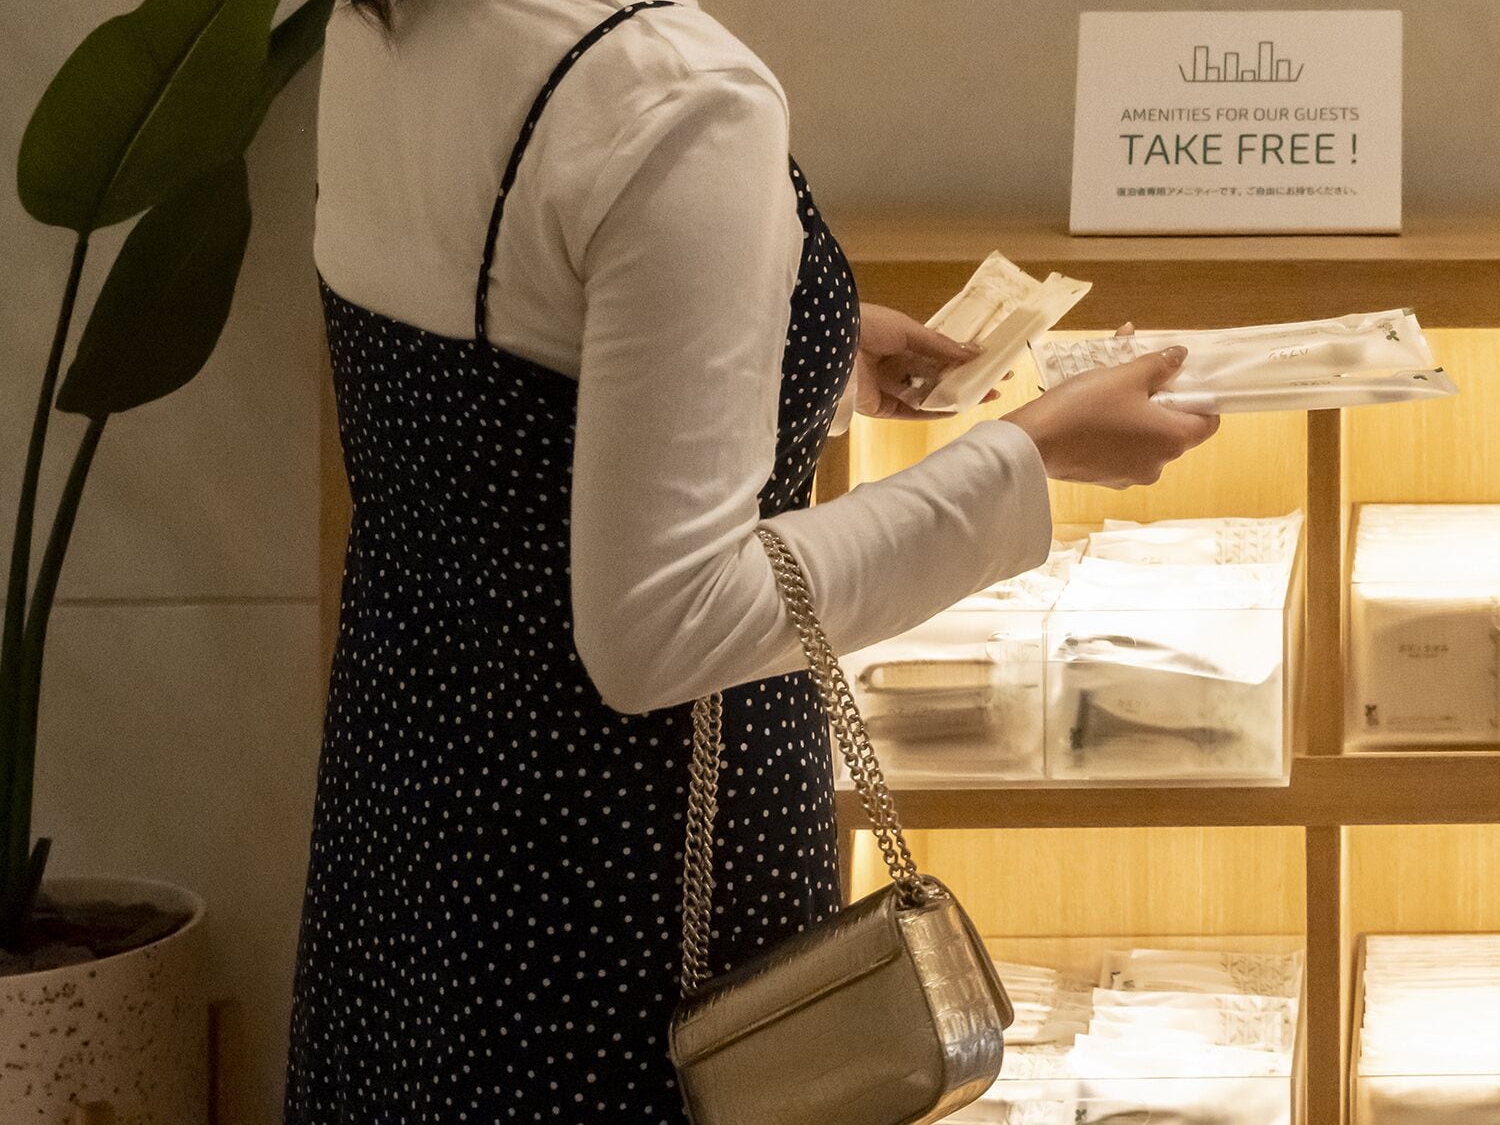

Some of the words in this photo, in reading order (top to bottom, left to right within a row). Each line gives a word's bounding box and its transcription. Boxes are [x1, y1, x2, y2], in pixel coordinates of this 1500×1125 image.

[1120, 108, 1212, 122] AMENITIES
[1216, 108, 1249, 122] FOR
[1253, 107, 1289, 122] OUR
[1293, 106, 1360, 121] GUESTS
[1119, 133, 1223, 166] TAKE
[1237, 132, 1336, 165] FREE
[1350, 132, 1358, 165] !
